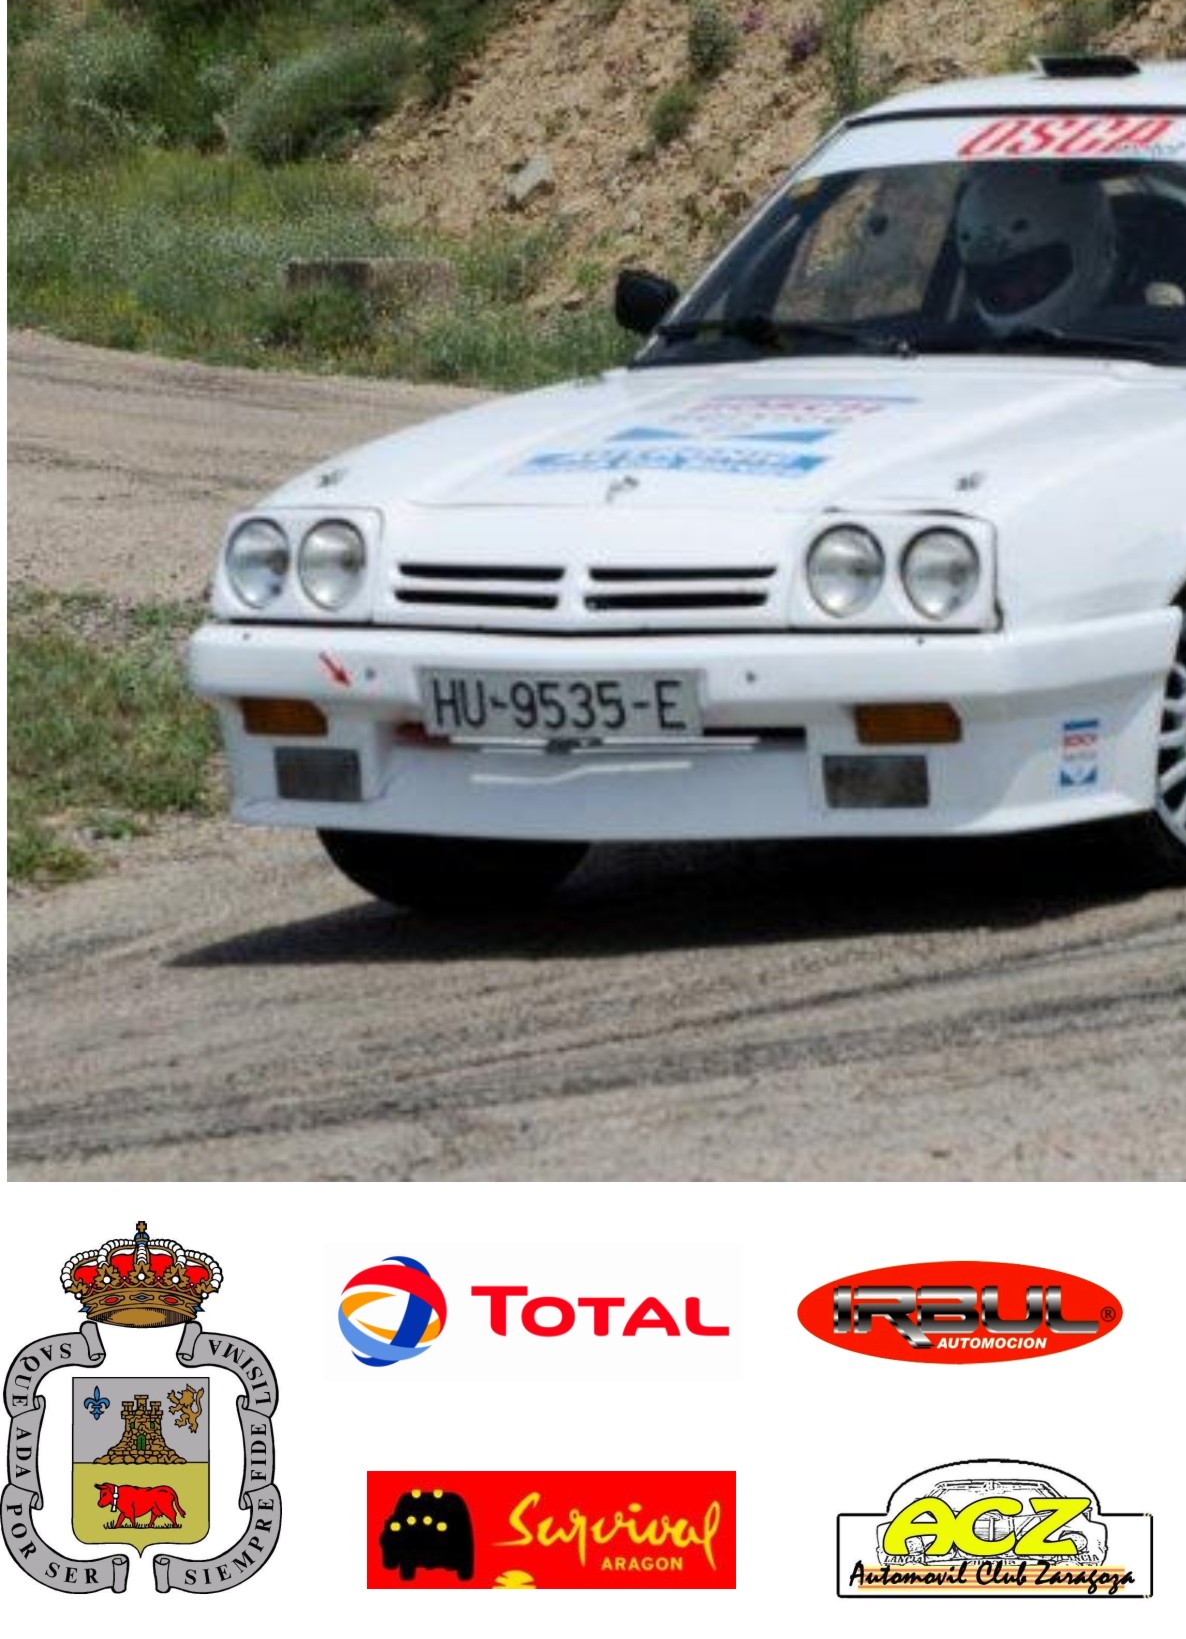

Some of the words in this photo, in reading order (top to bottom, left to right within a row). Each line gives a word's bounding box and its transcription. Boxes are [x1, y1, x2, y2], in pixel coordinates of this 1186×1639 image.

[433, 678, 687, 731] HU-9535-E
[833, 1285, 1099, 1349] IRBUL
[936, 1336, 1047, 1350] AUTOMOCION
[6, 1502, 38, 1559] POR
[184, 1497, 275, 1585] SIEMPRE
[491, 1491, 720, 1571] Survival
[883, 1496, 1092, 1557] ACZ
[44, 1562, 100, 1584] SER
[600, 1556, 683, 1571] ARAGON
[849, 1560, 967, 1587] Automovil
[976, 1560, 1028, 1587] Club
[1034, 1560, 1135, 1595] Zaragoza
